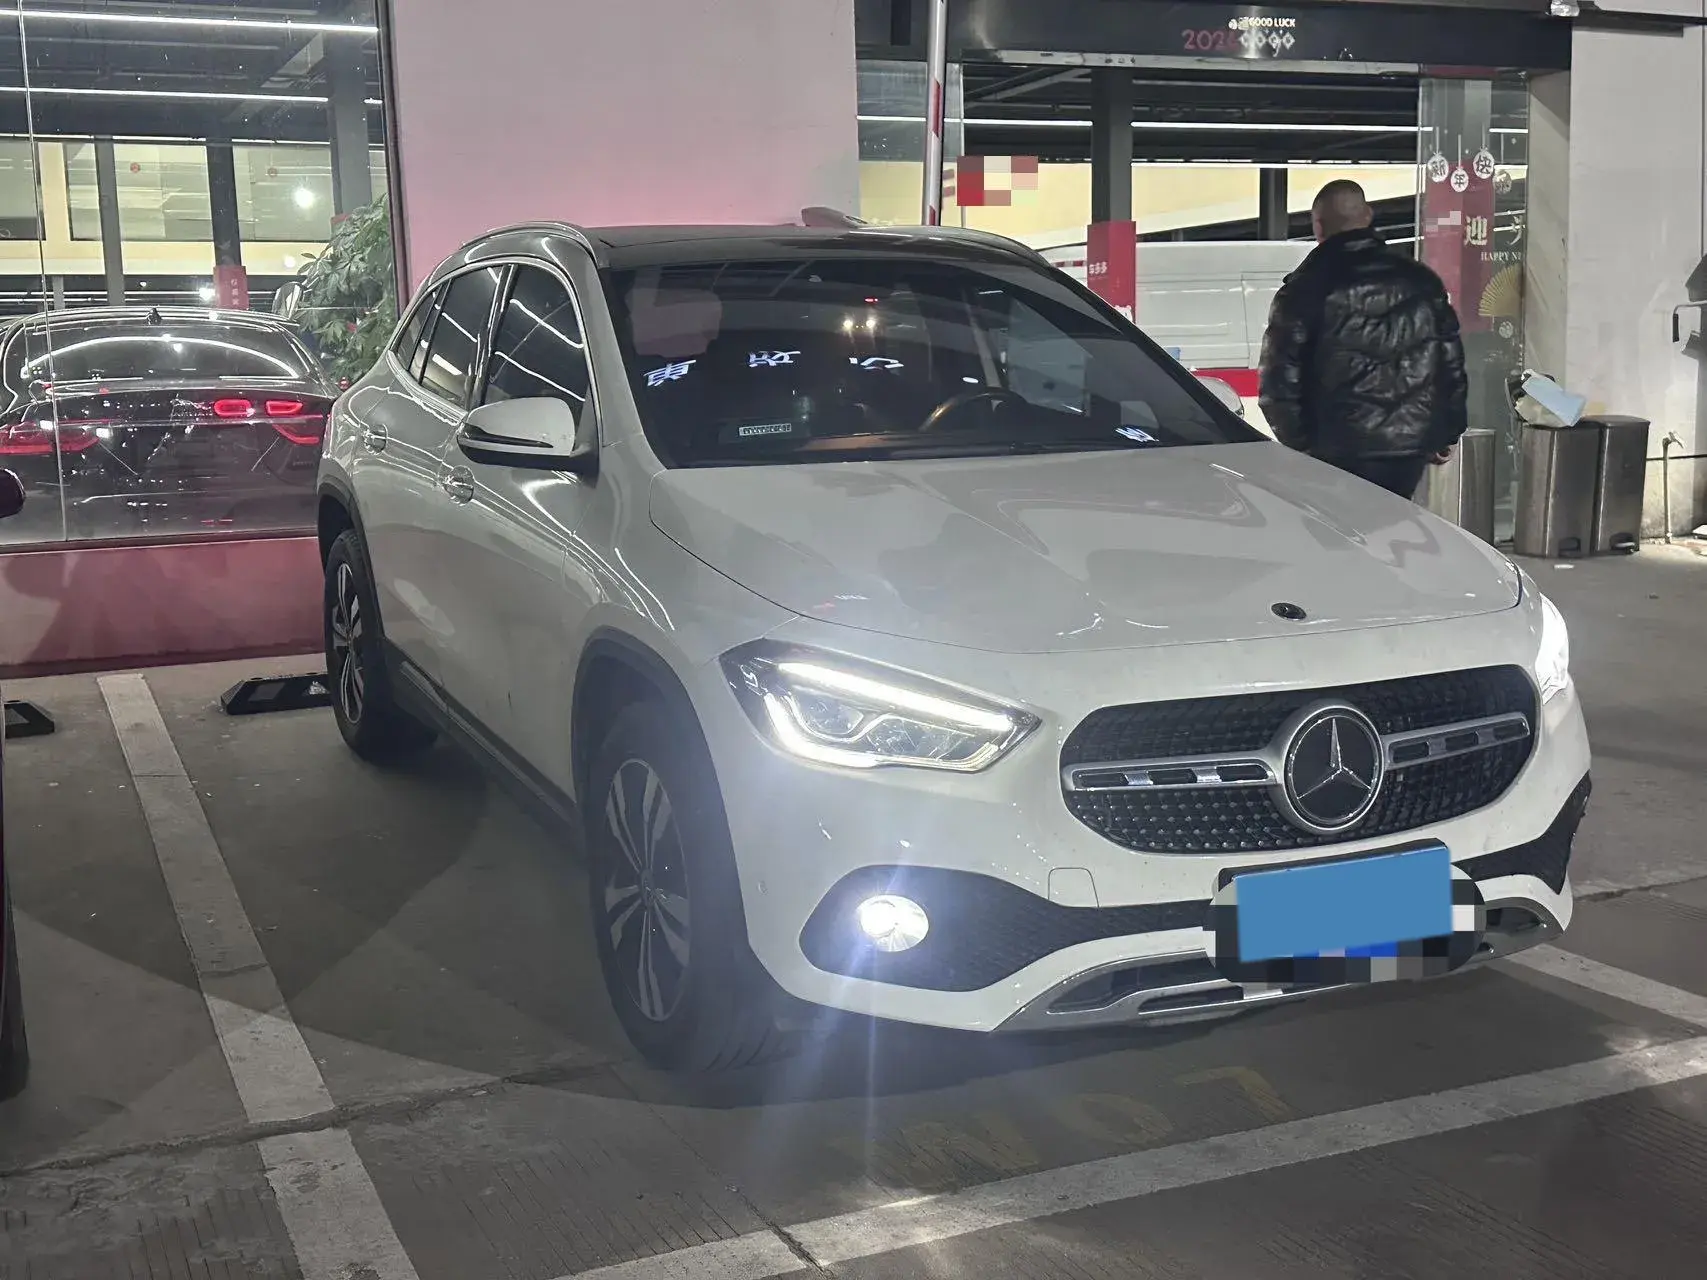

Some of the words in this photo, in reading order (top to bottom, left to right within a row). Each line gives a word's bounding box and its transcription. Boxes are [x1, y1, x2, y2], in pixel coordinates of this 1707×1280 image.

[1249, 16, 1274, 27] GOOD
[1274, 17, 1296, 28] LUCK
[1480, 251, 1509, 262] HAPPY
